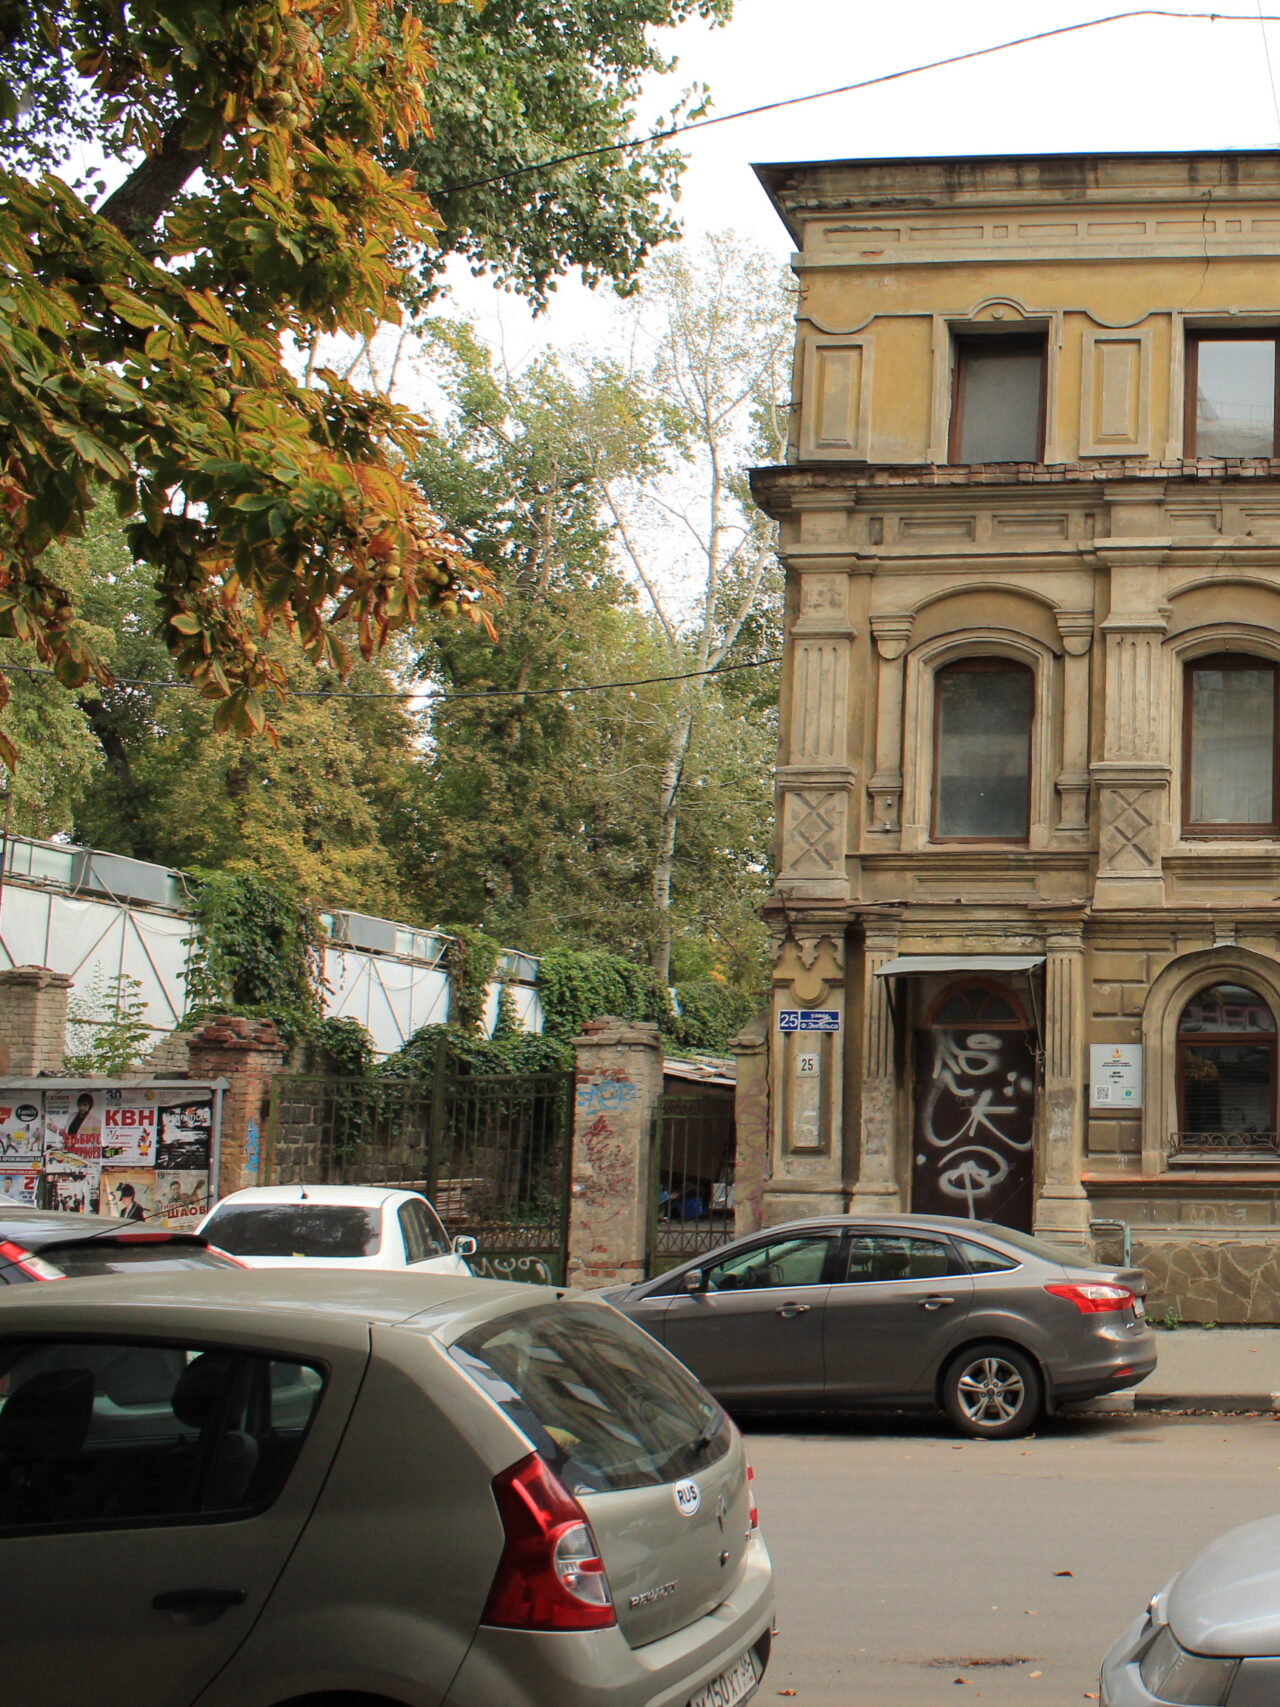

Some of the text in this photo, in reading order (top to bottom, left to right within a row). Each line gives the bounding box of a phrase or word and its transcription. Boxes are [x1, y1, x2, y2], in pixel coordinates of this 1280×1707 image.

[780, 1014, 798, 1027] 25
[801, 1058, 814, 1071] 25
[105, 1109, 155, 1127] КВН
[24, 1176, 36, 1190] 2
[167, 1205, 207, 1220] ШАОВ
[677, 1485, 698, 1506] RUS
